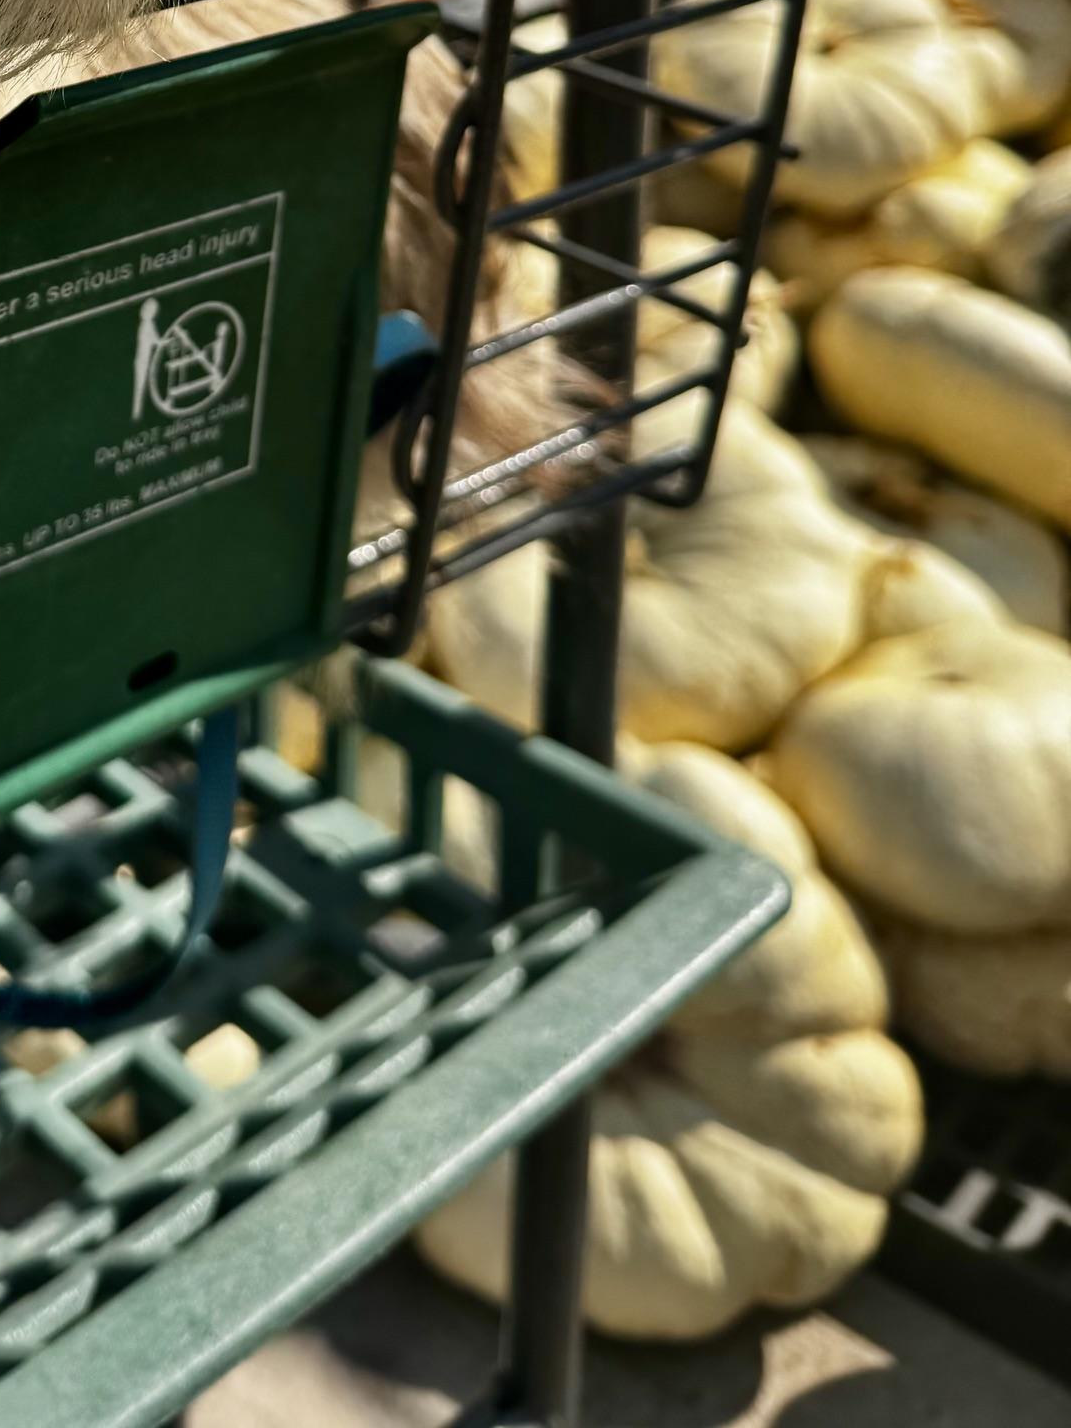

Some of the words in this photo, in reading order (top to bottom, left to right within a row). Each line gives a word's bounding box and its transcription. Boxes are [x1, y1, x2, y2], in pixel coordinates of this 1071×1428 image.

[25, 292, 40, 309] a
[45, 264, 133, 305] serious
[139, 239, 195, 275] head
[199, 223, 258, 256] injury
